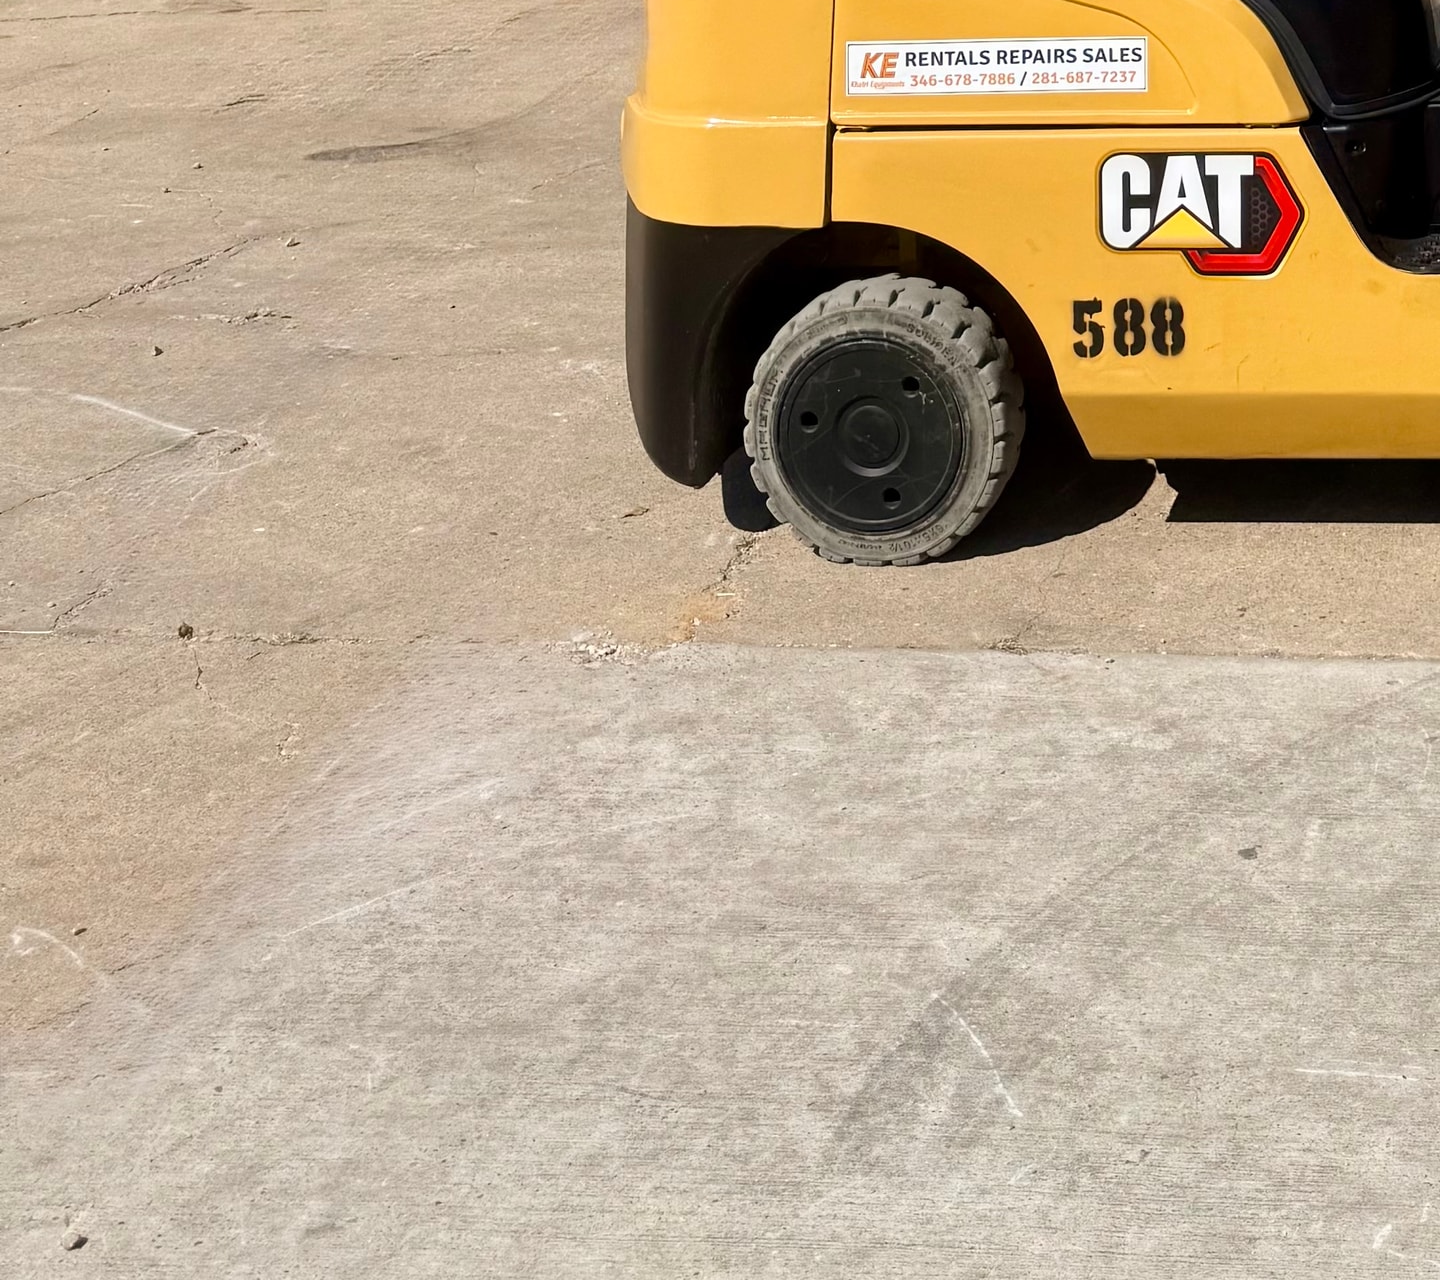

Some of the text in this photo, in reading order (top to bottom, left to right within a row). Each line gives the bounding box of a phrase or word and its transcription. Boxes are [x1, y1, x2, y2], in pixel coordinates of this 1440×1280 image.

[860, 52, 899, 79] KE
[905, 47, 1143, 67] RENTALS REPAIRS SALES
[910, 70, 1137, 87] 346-678-7886 / 281-687-7237
[1101, 154, 1255, 249] CAT
[1072, 296, 1186, 358] 588
